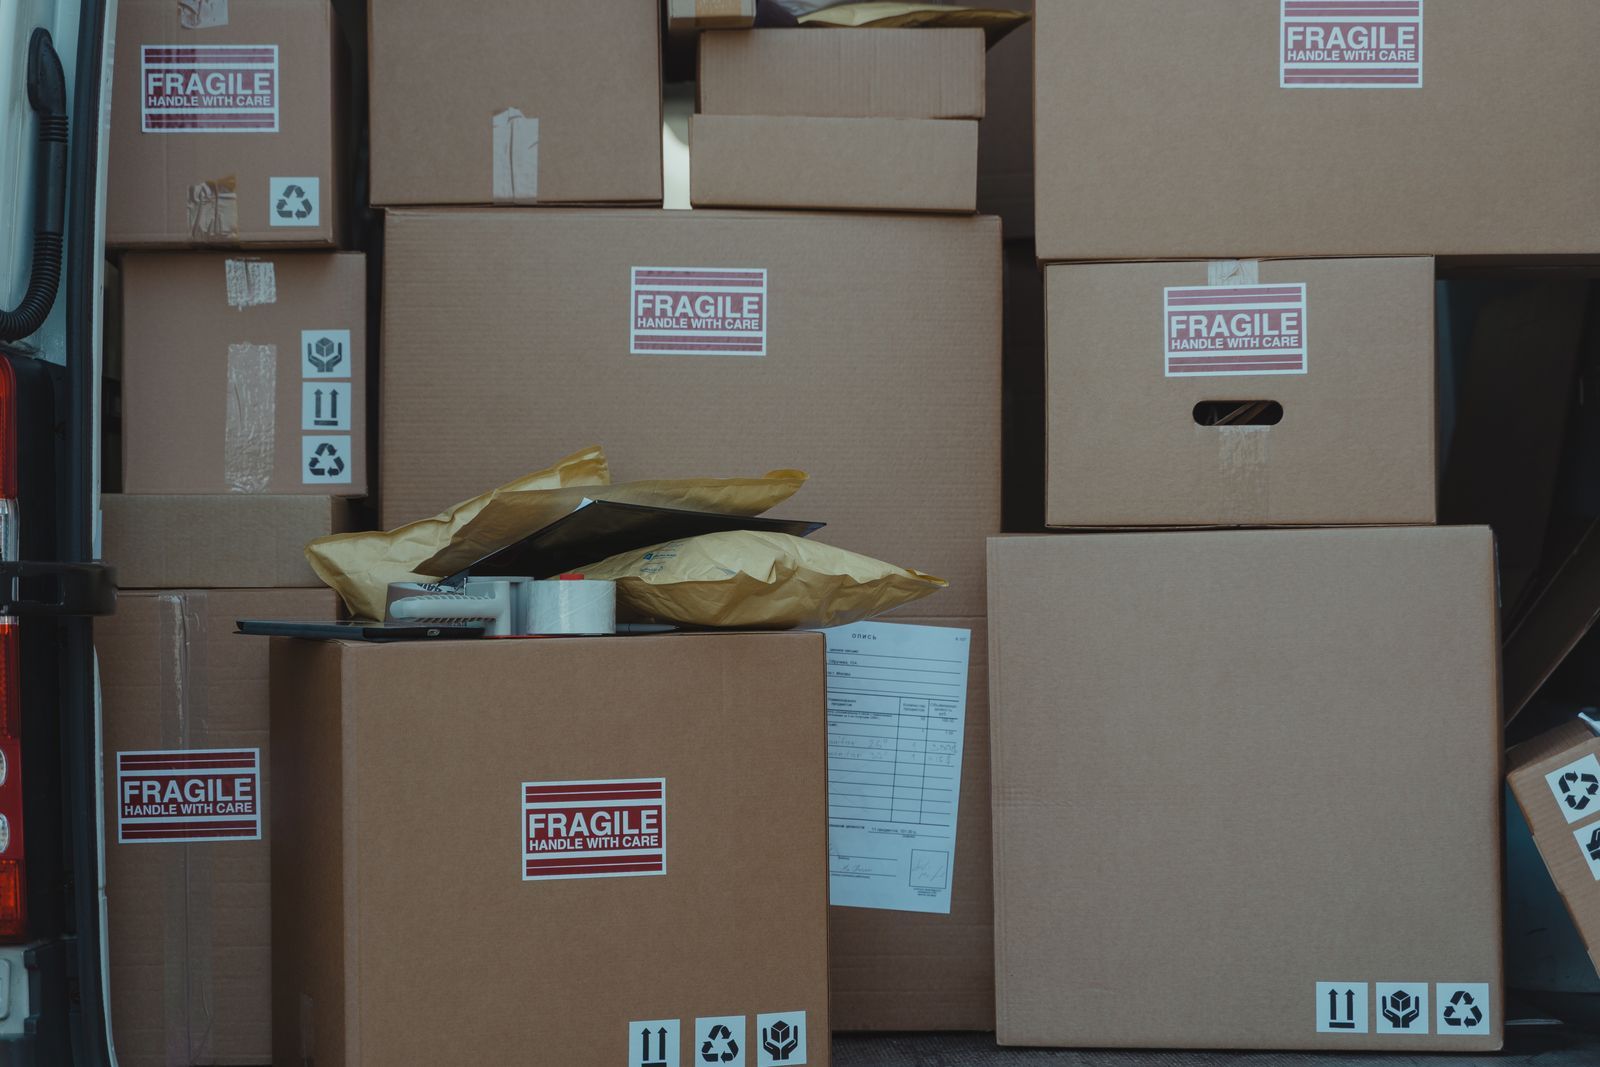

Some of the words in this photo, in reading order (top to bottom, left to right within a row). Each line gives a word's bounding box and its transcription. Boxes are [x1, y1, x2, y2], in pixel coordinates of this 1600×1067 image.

[1287, 26, 1416, 50] FRAGILE
[1287, 50, 1340, 61] HANDLE
[1343, 50, 1376, 61] WITH
[1379, 50, 1415, 61] CARE
[148, 72, 272, 95] FRAGILE
[148, 95, 199, 106] HANDLE
[203, 95, 233, 106] WITH
[236, 95, 271, 107] CARE
[637, 294, 760, 318] FRAGILE
[637, 317, 688, 328] HANDLE
[691, 318, 722, 329] WITH
[725, 318, 759, 330] CARE
[1171, 312, 1299, 338] FRAGILE
[1172, 338, 1224, 351] HANDLE
[1226, 337, 1260, 349] WITH
[1262, 336, 1299, 348] CARE
[124, 777, 253, 804] FRAGILE
[124, 804, 178, 816] HANDLE
[181, 802, 213, 815] WITH
[216, 801, 253, 814] CARE
[529, 809, 659, 839] FRAGILE
[529, 838, 584, 852] HANDLE
[587, 836, 619, 850] WITH
[622, 834, 659, 848] CARE
